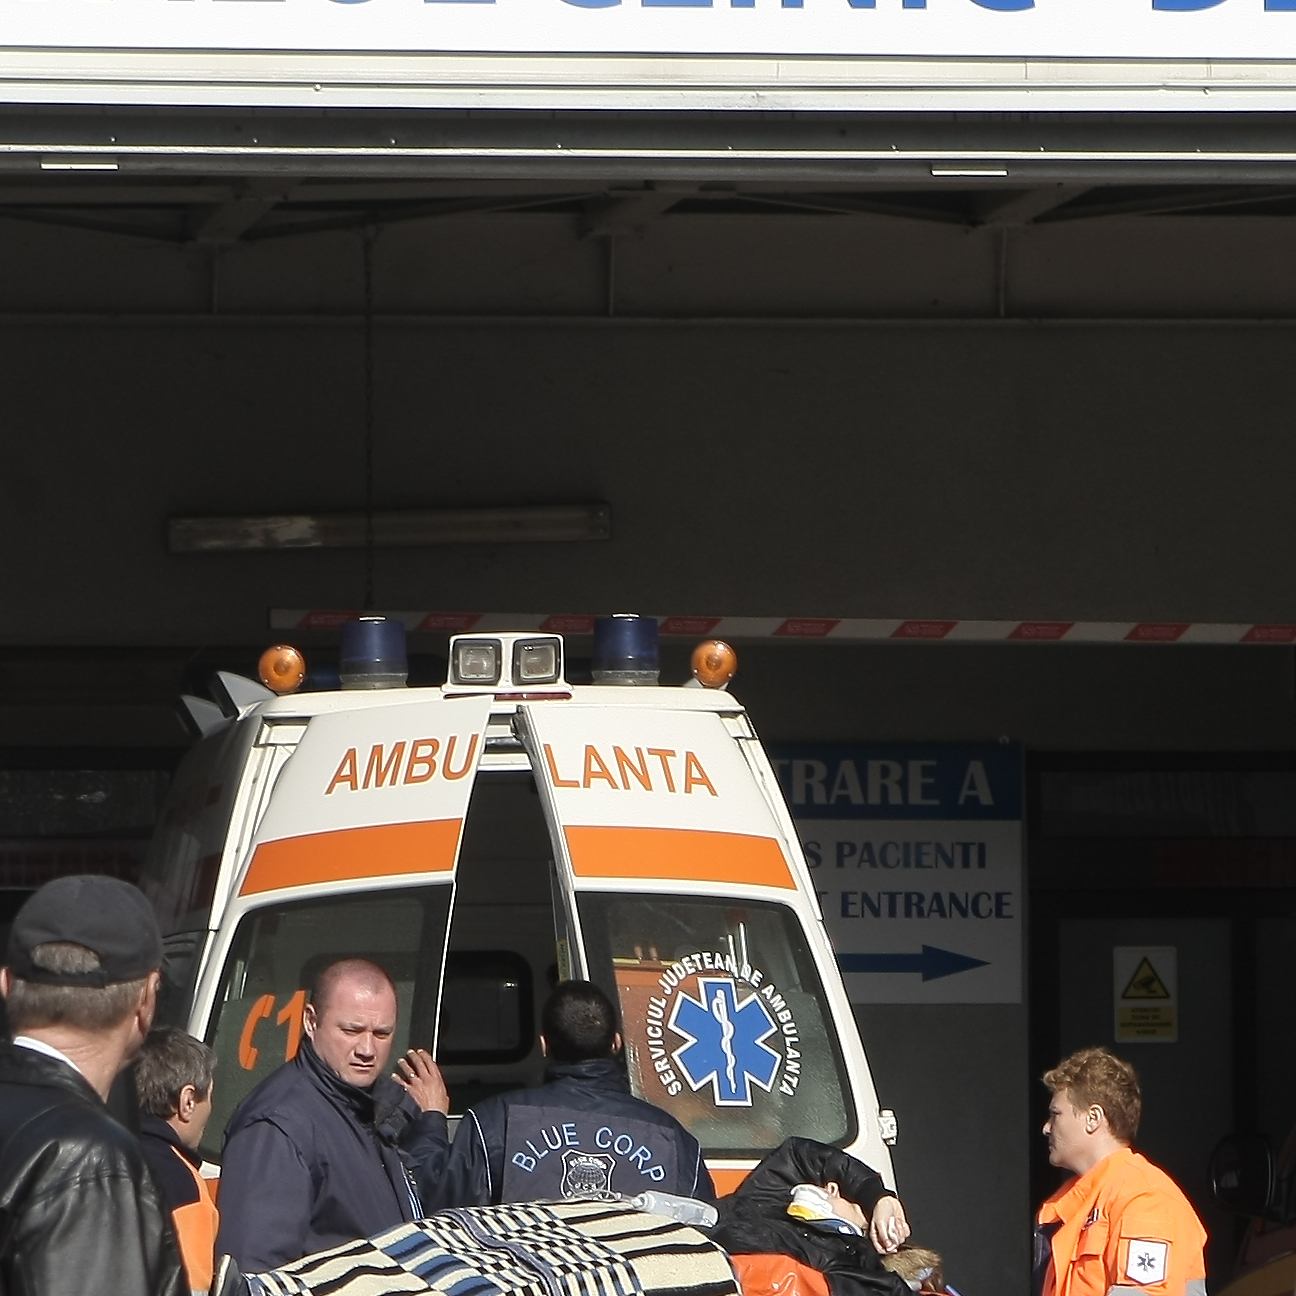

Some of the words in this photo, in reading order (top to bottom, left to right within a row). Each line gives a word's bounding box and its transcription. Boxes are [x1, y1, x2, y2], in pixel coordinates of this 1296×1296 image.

[324, 733, 479, 796] AMBU
[543, 743, 719, 797] LANTA
[958, 759, 994, 805] A
[836, 841, 986, 869] PACIENTI
[841, 891, 1014, 919] ENTRANCE
[646, 995, 683, 1096] SERVICIUL
[761, 984, 802, 1096] AMBULANTA
[511, 1123, 580, 1173] BLUE
[595, 1127, 666, 1182] CORP
